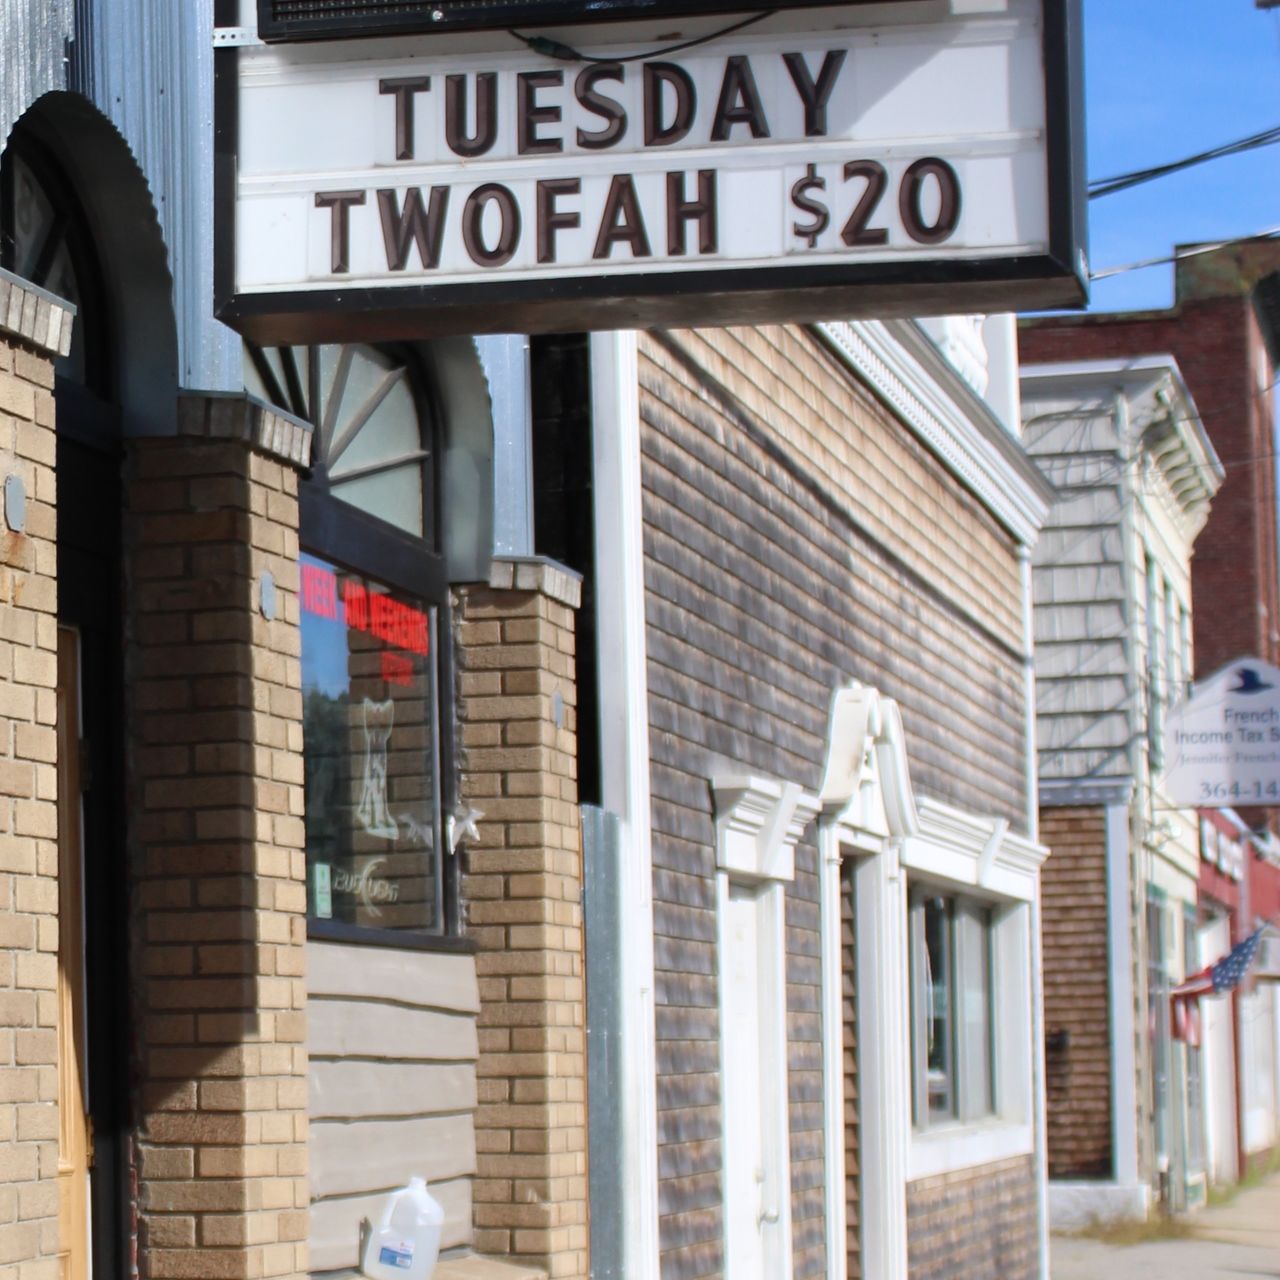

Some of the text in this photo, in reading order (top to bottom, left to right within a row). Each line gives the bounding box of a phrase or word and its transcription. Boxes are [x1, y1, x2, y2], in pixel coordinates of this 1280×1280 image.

[378, 49, 846, 161] TUESDAY
[315, 157, 962, 275] TWOFAH $20
[1175, 729, 1233, 744] Income
[1237, 727, 1264, 743] Tax
[1224, 707, 1280, 722] French
